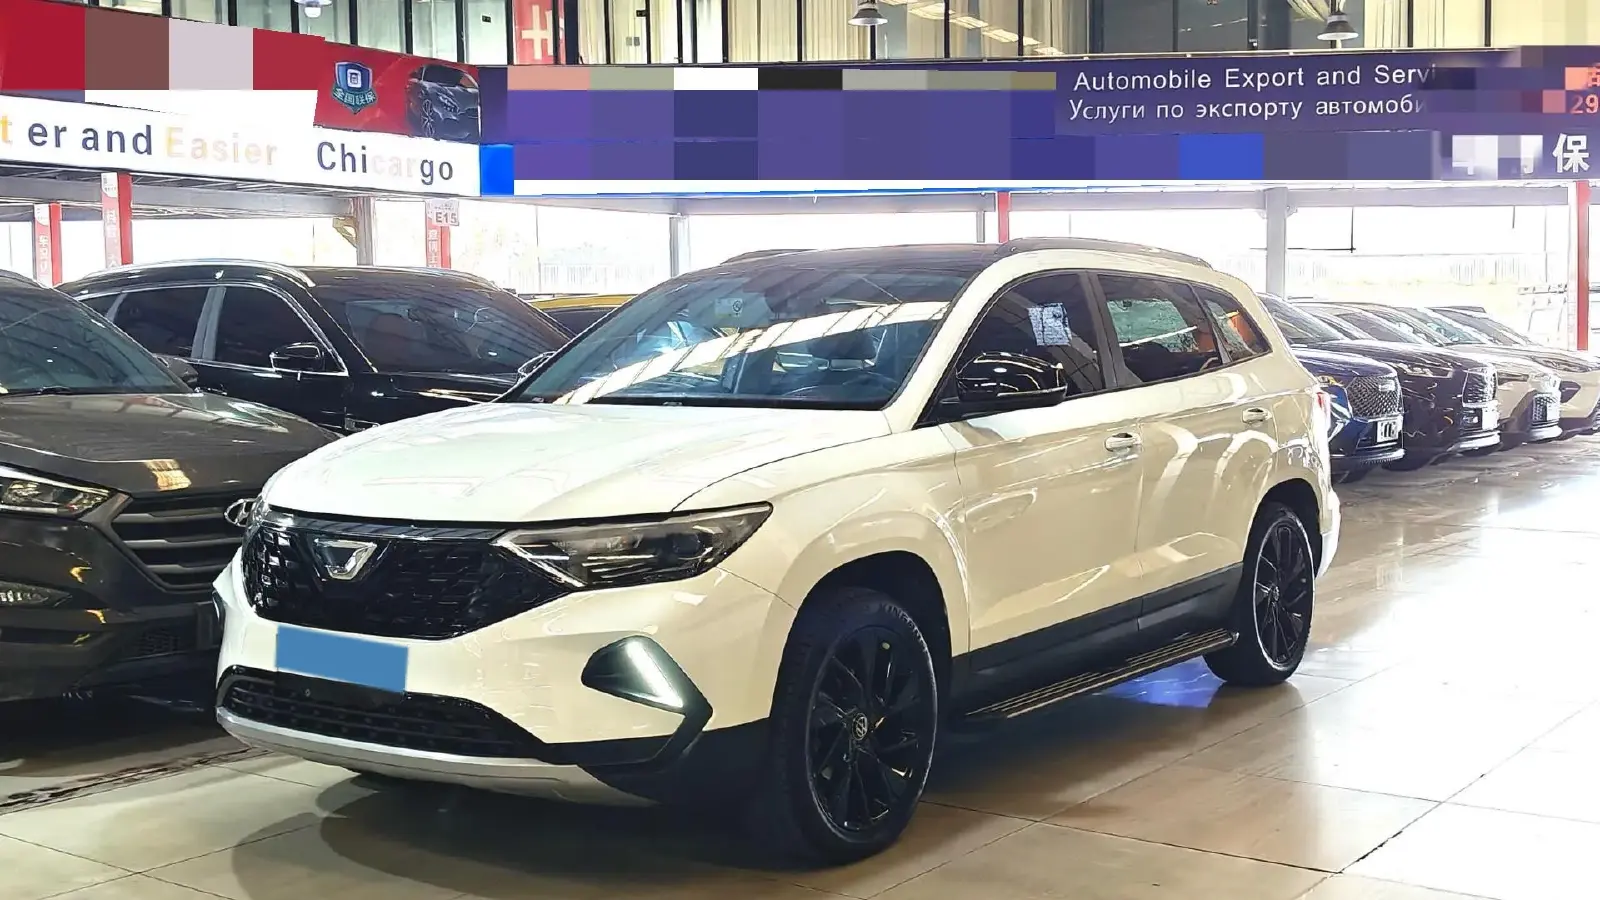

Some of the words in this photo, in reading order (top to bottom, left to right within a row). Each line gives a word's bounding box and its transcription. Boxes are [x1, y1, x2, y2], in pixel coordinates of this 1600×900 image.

[1073, 69, 1212, 91] Automobile
[1225, 67, 1304, 92] Export
[1317, 65, 1361, 86] and
[1069, 99, 1145, 124] Услуги
[1156, 103, 1184, 118] по
[1195, 101, 1303, 121] экспорту
[81, 124, 153, 156] and
[166, 126, 279, 166] Easier
[317, 141, 454, 186] Chicargo
[435, 211, 457, 224] E15
